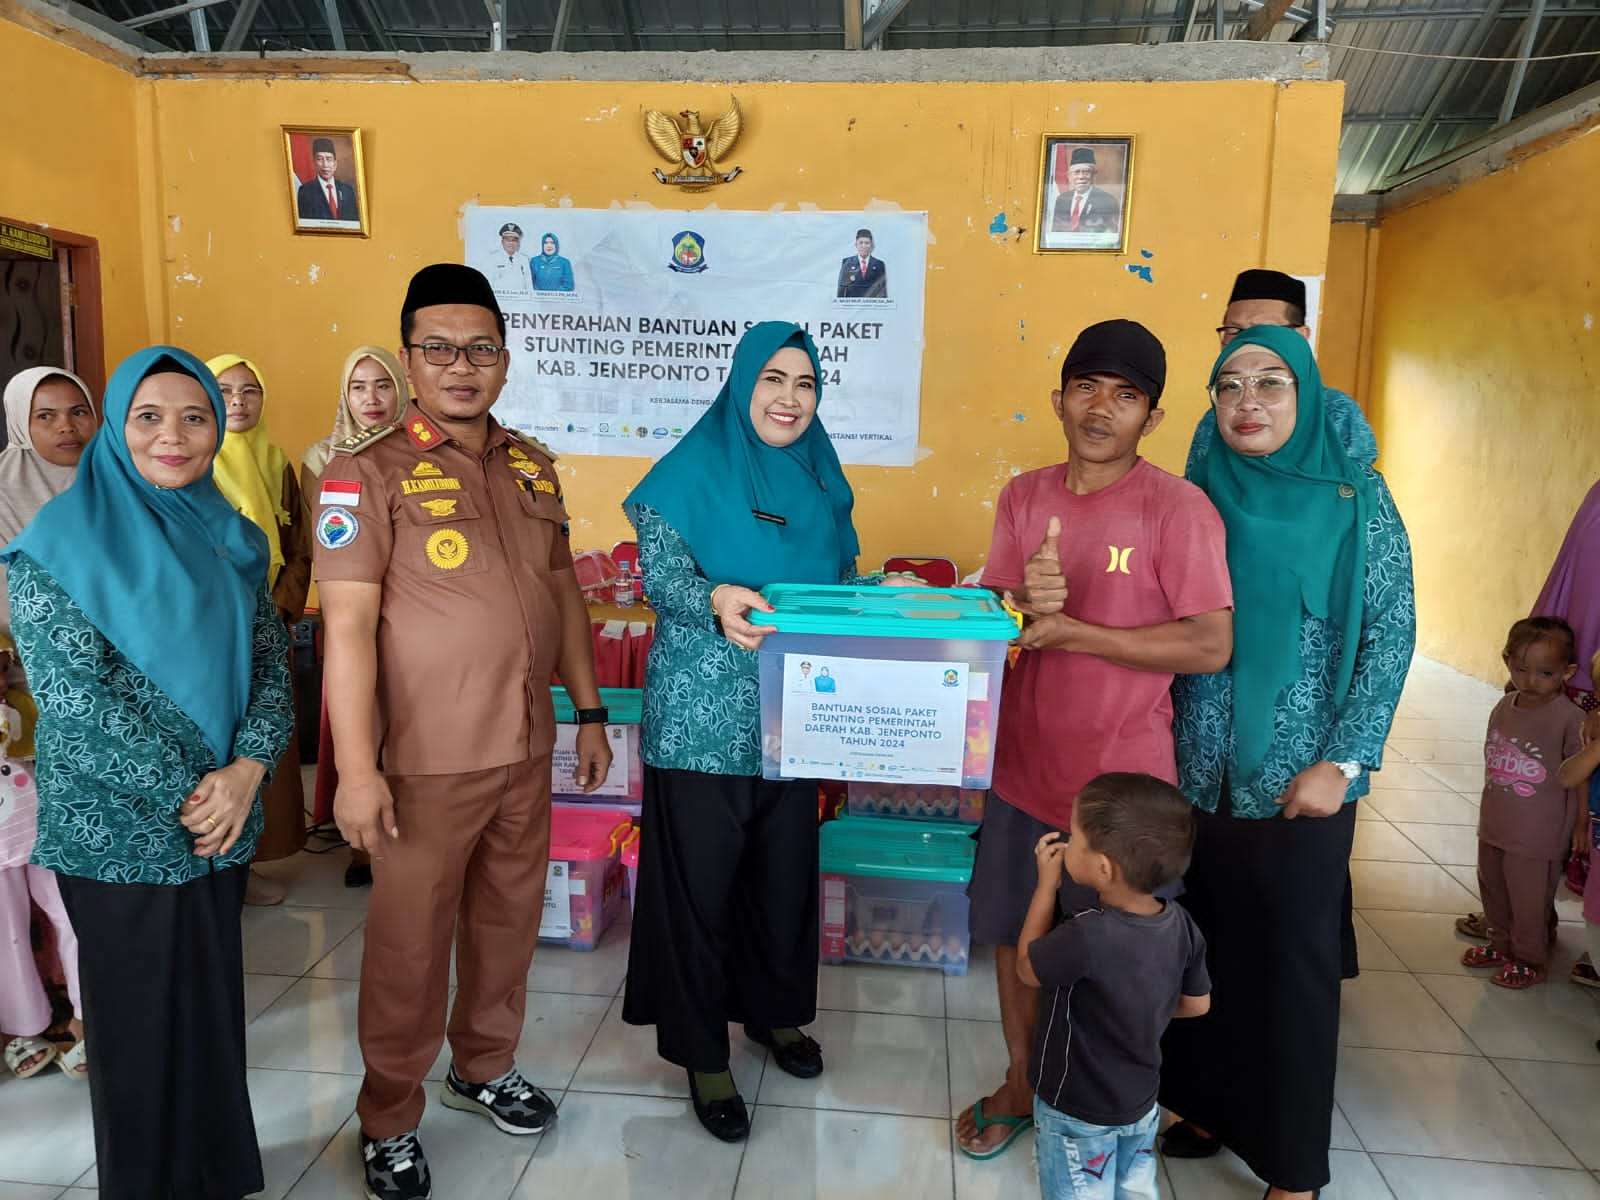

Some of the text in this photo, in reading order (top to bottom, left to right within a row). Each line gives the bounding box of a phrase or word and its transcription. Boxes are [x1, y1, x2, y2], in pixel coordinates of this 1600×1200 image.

[639, 318, 737, 336] BANTUAN
[820, 322, 884, 339] PAKET
[524, 336, 735, 360] STUNTING PEMERINT
[537, 359, 581, 377] KAB.
[589, 361, 709, 382] JENEPONTO
[649, 397, 690, 405] KERJASAMA
[860, 433, 893, 441] VERTIKAL
[811, 702, 937, 718] BANTUAN SOSIAL PAKET
[811, 713, 936, 728] STUNTING PEMERINTAH
[805, 723, 942, 740] DAERAH KAB. JENEPONTO
[840, 736, 905, 748] TAHUN 2024
